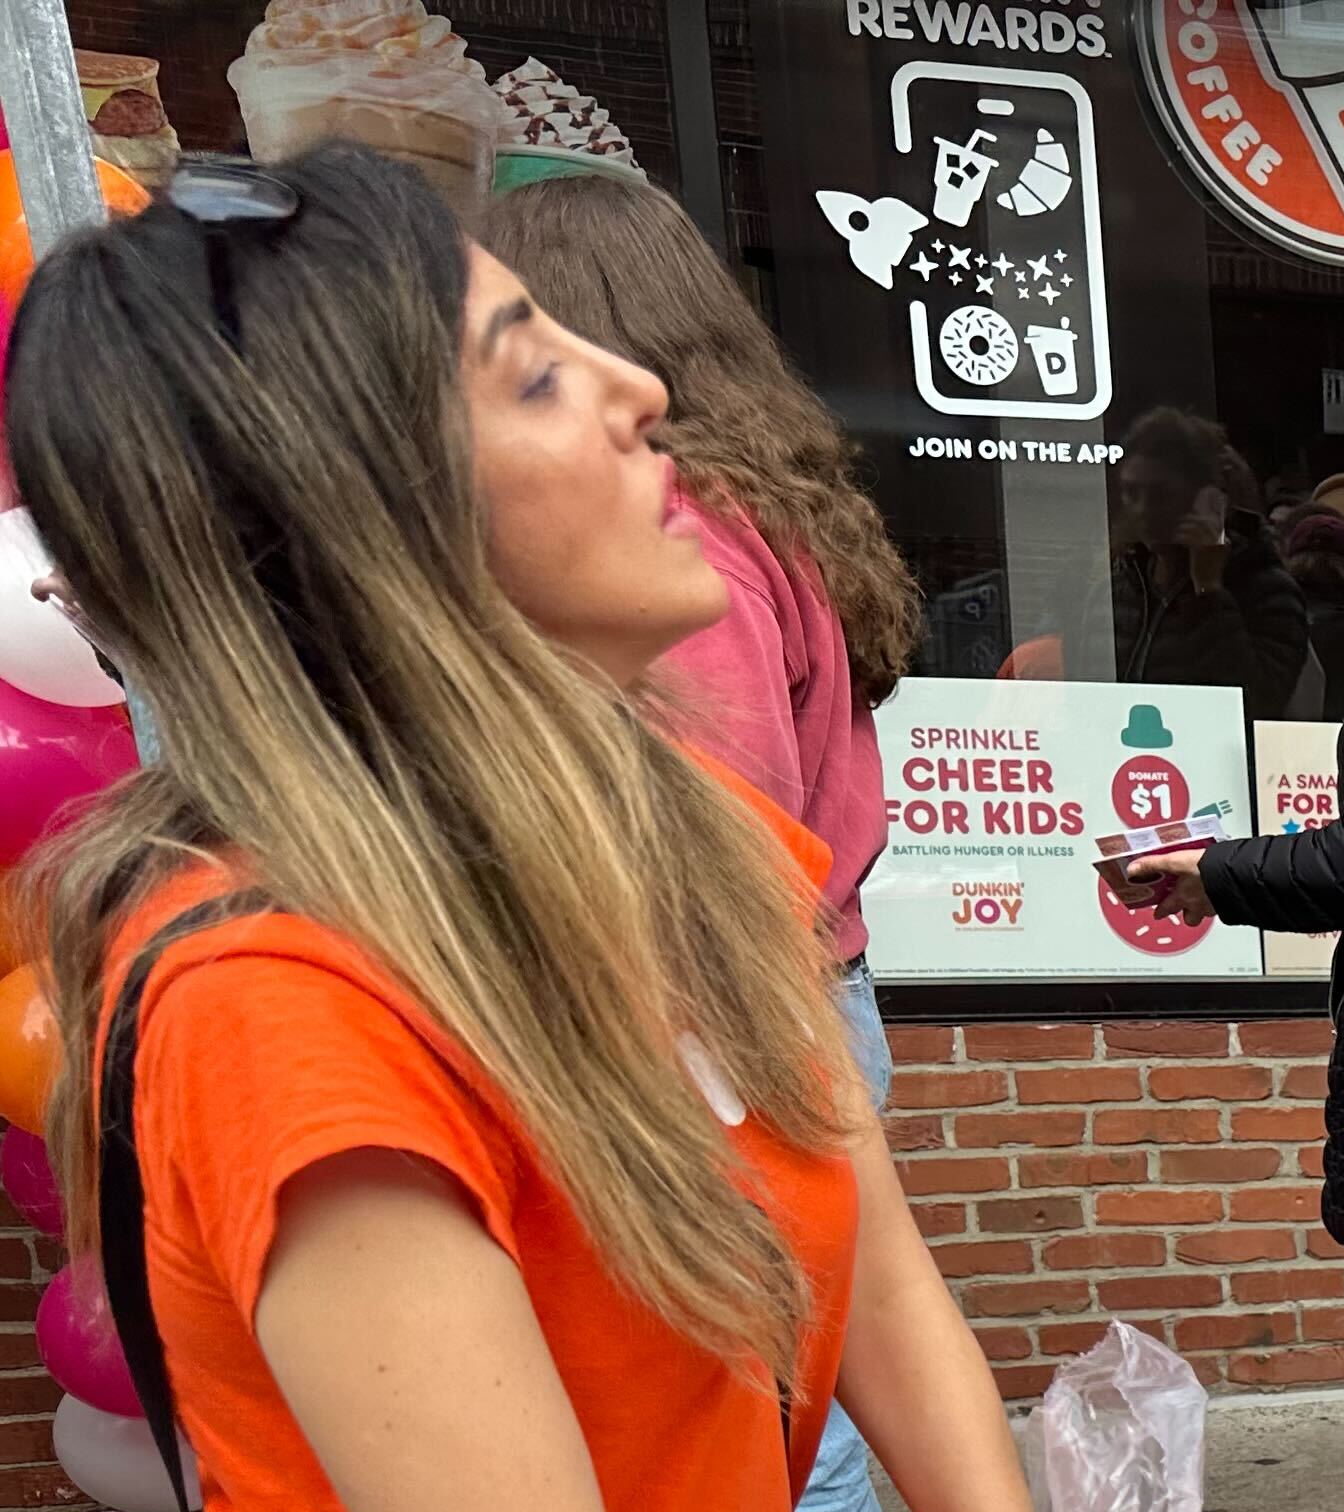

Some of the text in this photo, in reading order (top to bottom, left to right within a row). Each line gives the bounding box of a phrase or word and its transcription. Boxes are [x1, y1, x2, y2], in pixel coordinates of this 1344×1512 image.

[847, 0, 1106, 57] REWARDS
[909, 436, 1124, 465] JOIN ON THE APP
[911, 728, 1040, 750] SPRINKLE
[902, 757, 1054, 793] CHEER
[1128, 771, 1169, 781] DONATE
[1277, 775, 1291, 789] A
[1130, 784, 1171, 820] $1
[1277, 793, 1332, 814] FOR
[886, 800, 1085, 835] FOR KIDS
[892, 846, 1075, 857] BATTLING HUNGER OR ILLNESS
[952, 882, 1025, 897] DUNKIN'
[952, 899, 1023, 924] JOY
